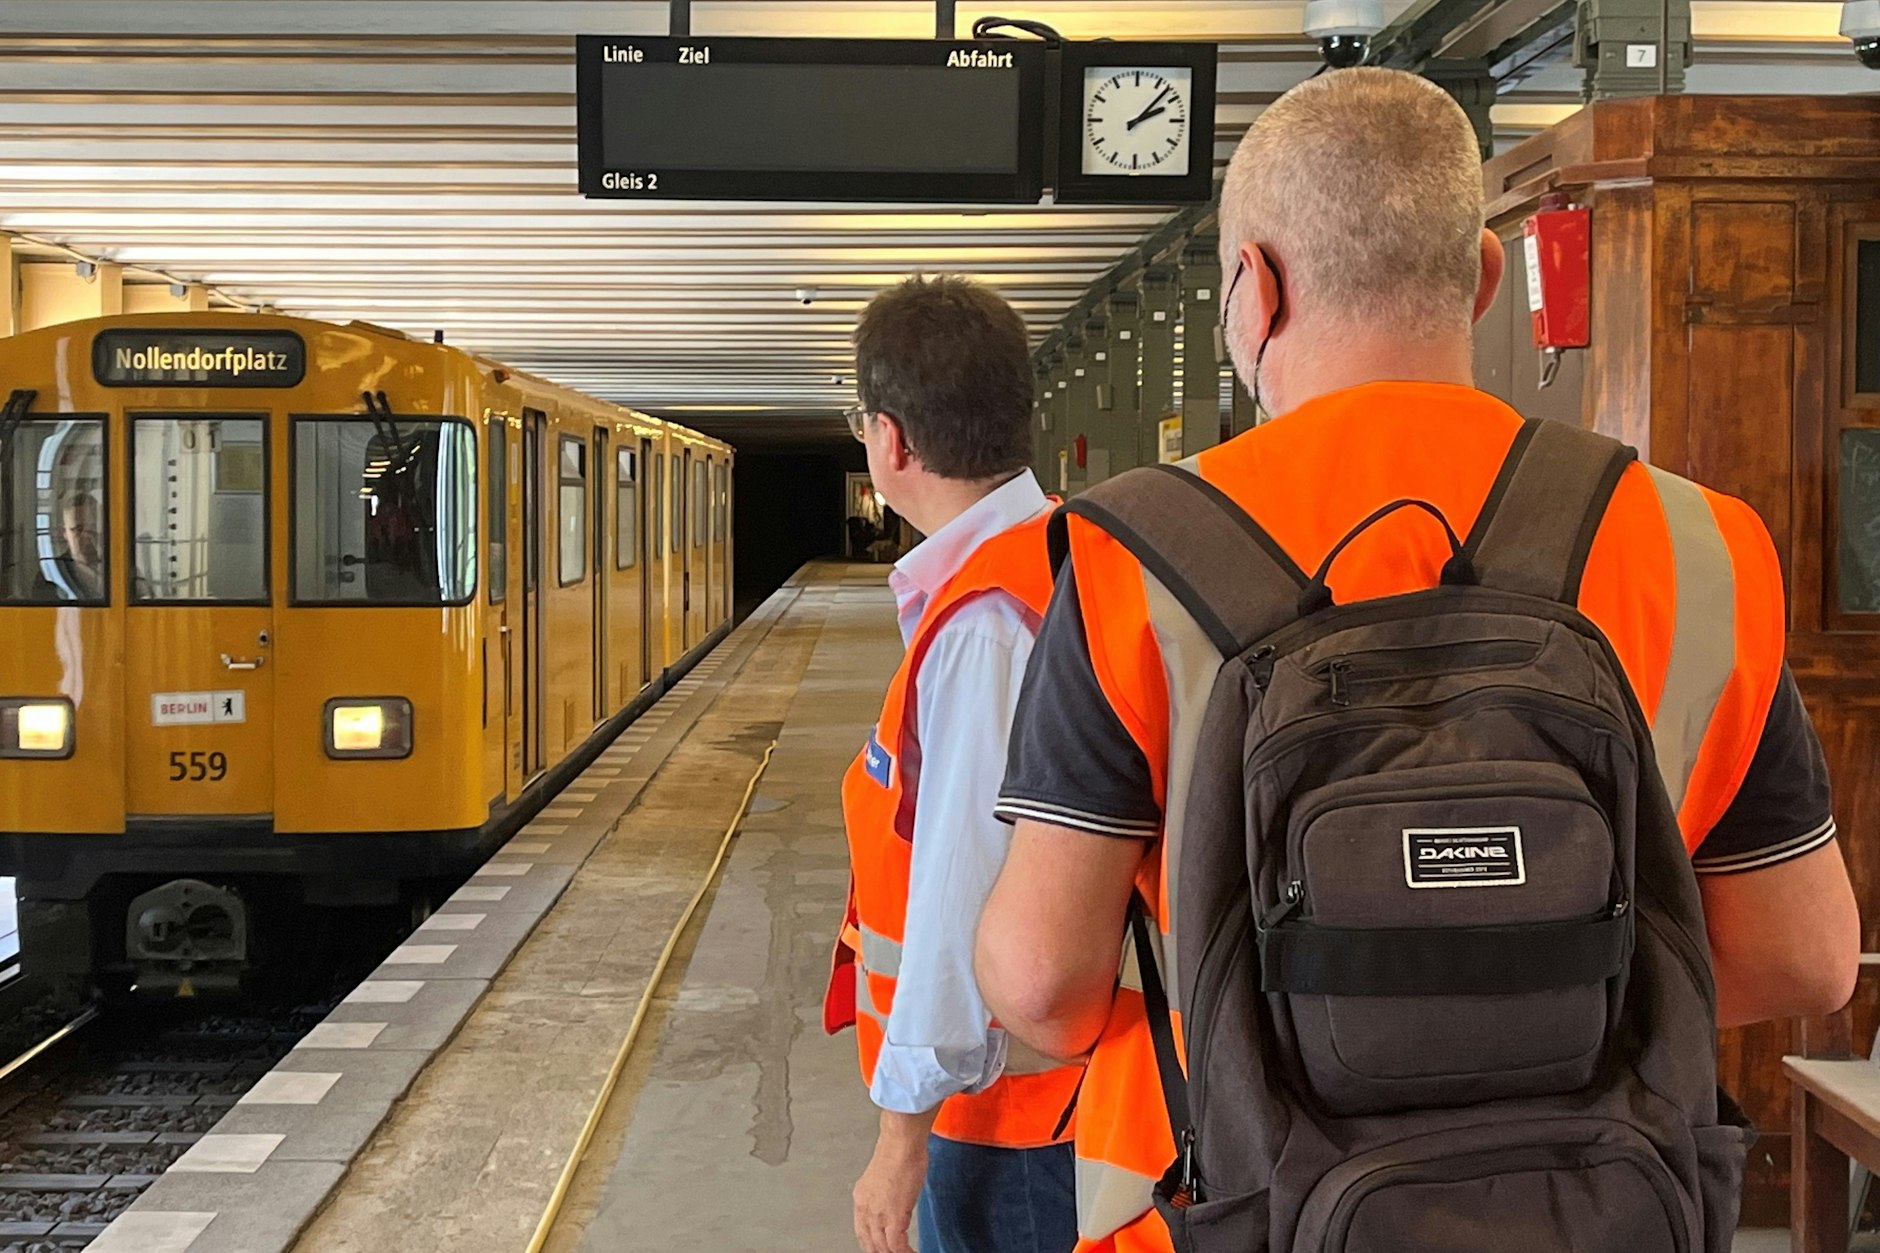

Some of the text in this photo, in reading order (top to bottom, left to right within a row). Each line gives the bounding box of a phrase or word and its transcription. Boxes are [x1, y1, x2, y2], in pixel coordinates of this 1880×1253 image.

[603, 45, 644, 63] Linie
[678, 46, 710, 65] Ziel
[946, 50, 1014, 69] Abfahrt
[1637, 49, 1647, 63] 7
[601, 172, 658, 190] Gleis 2
[116, 346, 288, 376] Nollendorfplatz
[160, 702, 207, 715] BERLIN
[169, 751, 228, 782] 559
[1418, 845, 1509, 860] DAKINE
